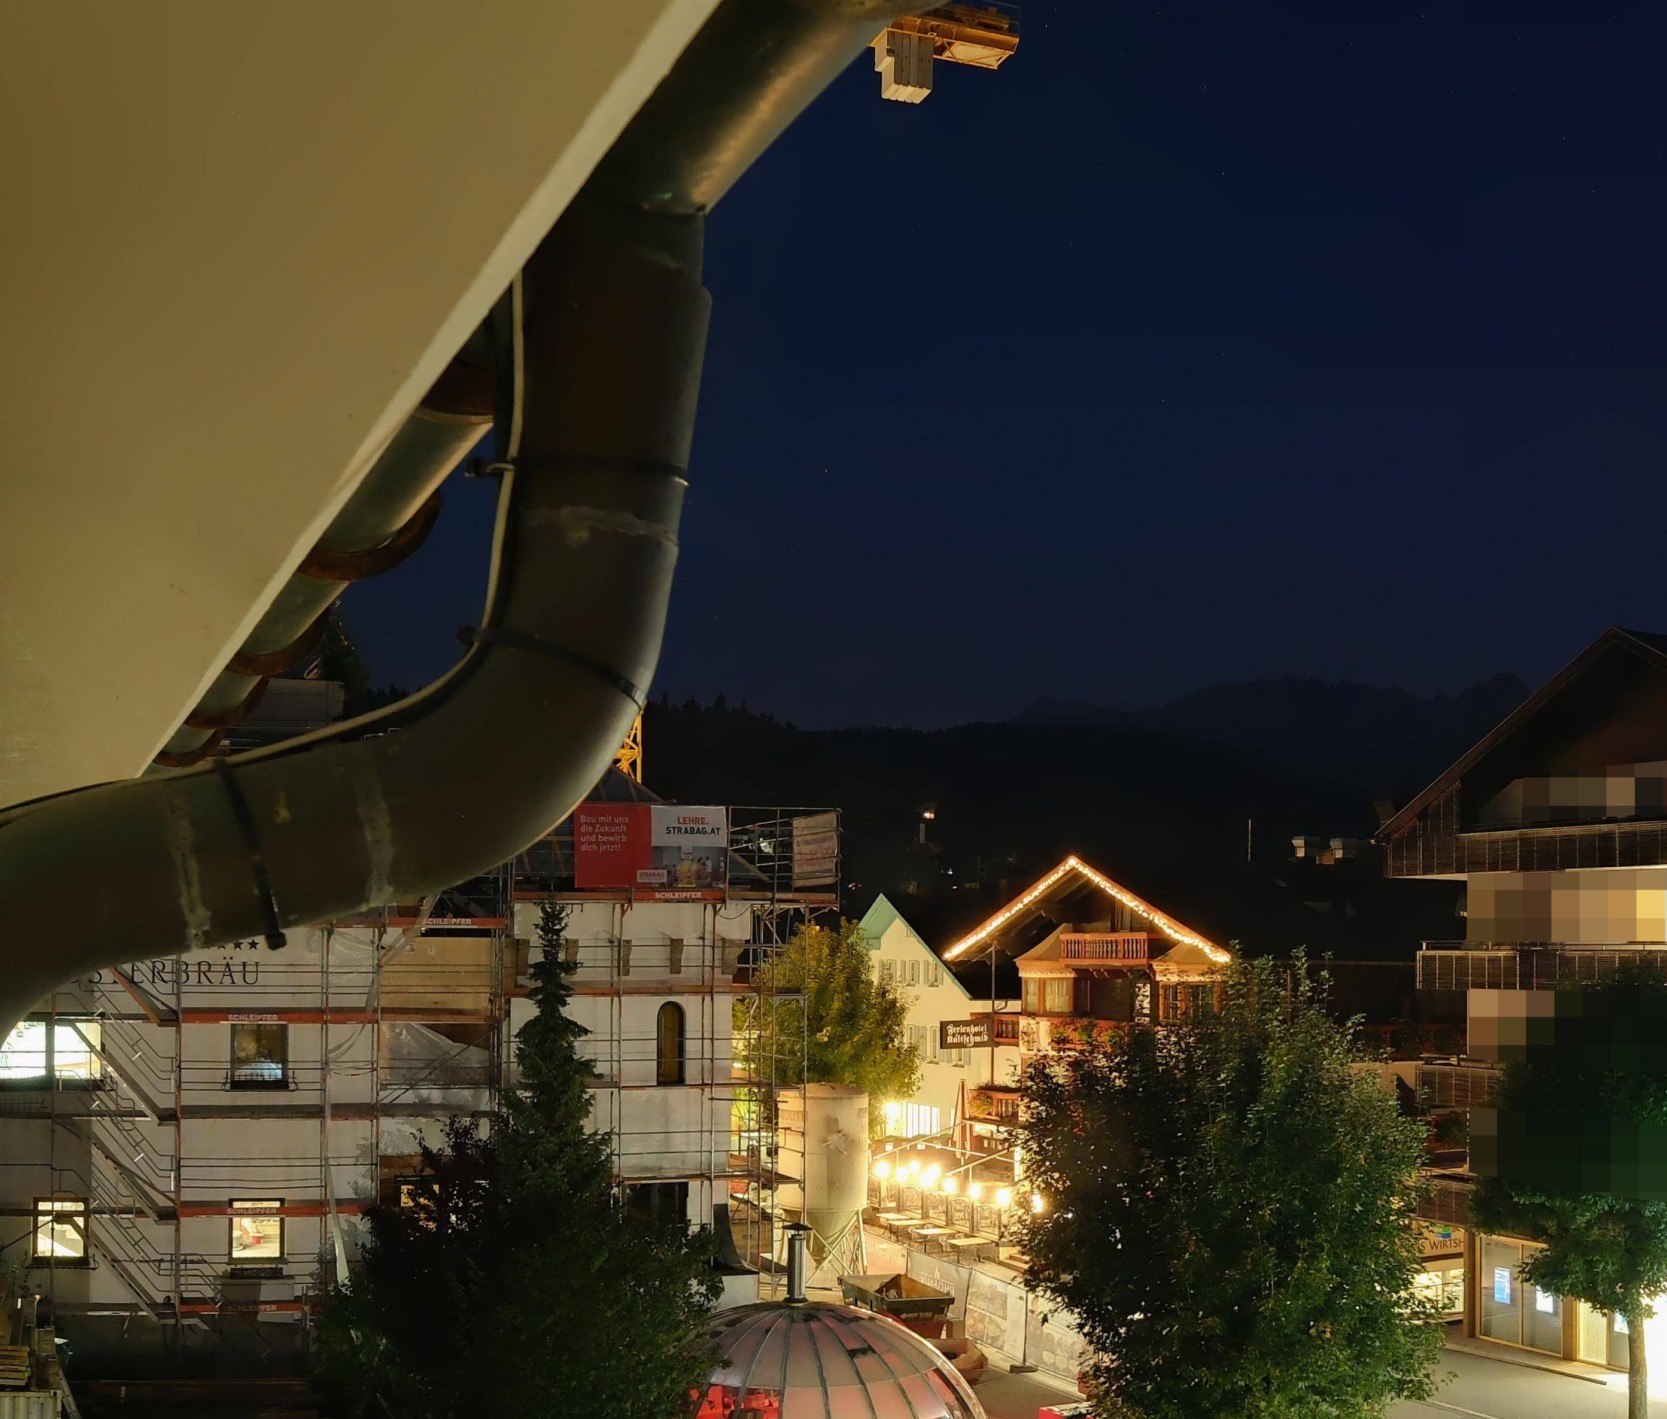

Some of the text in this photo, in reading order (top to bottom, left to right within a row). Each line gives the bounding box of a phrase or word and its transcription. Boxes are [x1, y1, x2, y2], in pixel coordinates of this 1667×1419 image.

[580, 815, 597, 823] Bau
[598, 815, 612, 823] mit
[677, 817, 709, 825] LEHRE.
[580, 824, 627, 833] die Zukunft
[666, 826, 721, 835] STRABAG.AT
[580, 834, 627, 842] und bewirb
[580, 843, 621, 853] dich jetzt!
[228, 1013, 279, 1021] SCHLEIPFER
